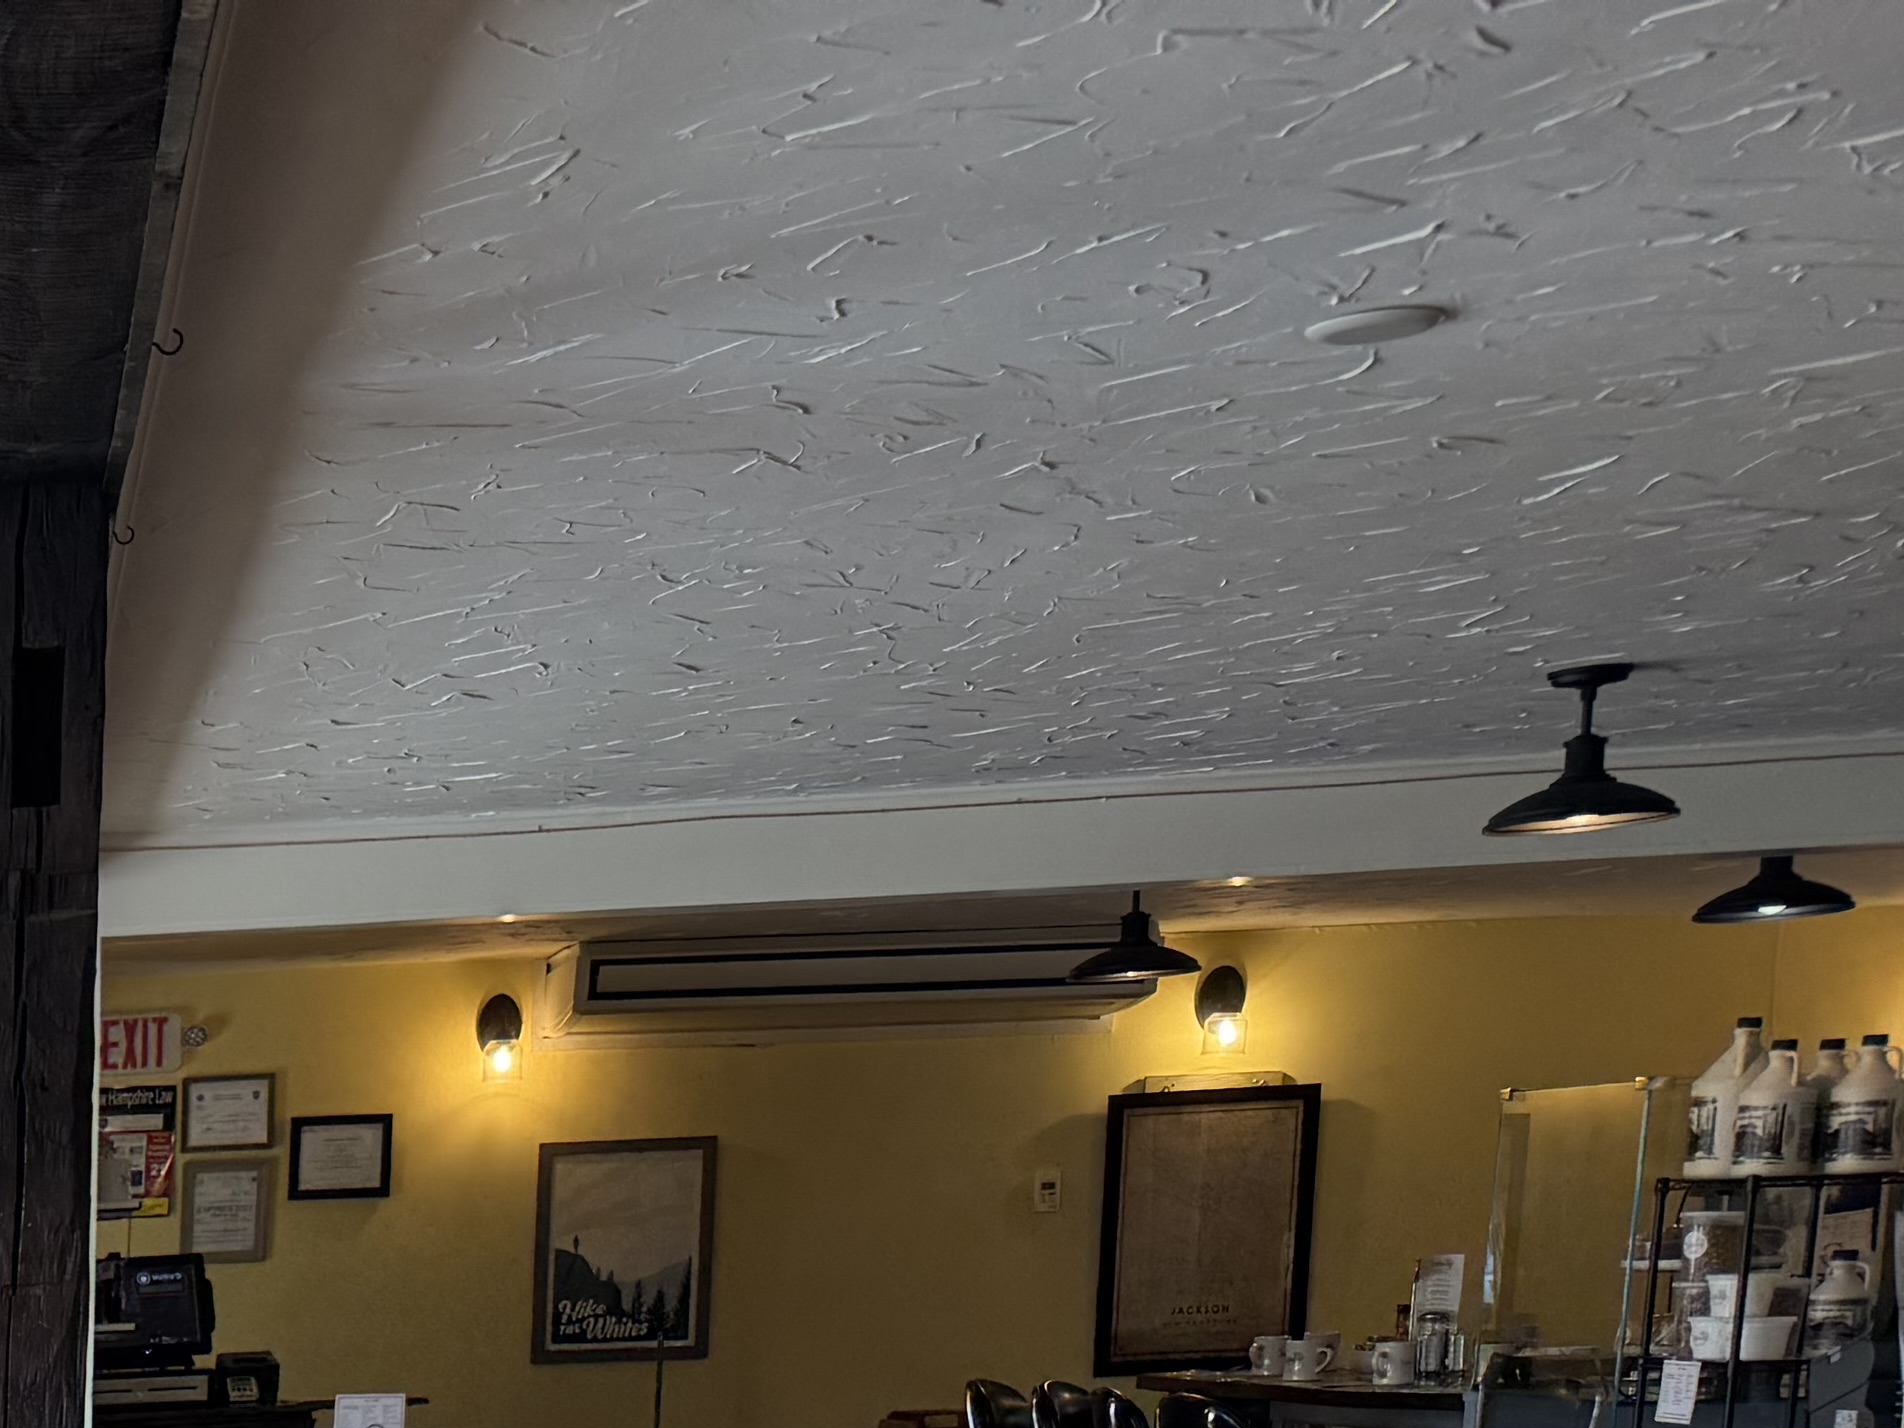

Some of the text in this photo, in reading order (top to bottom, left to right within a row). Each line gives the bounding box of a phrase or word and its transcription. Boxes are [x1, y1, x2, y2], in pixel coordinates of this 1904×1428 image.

[101, 1016, 169, 1070] EXIT
[558, 1299, 608, 1324] Hike
[1170, 1304, 1230, 1316] JACKSON
[583, 1314, 650, 1340] Whites
